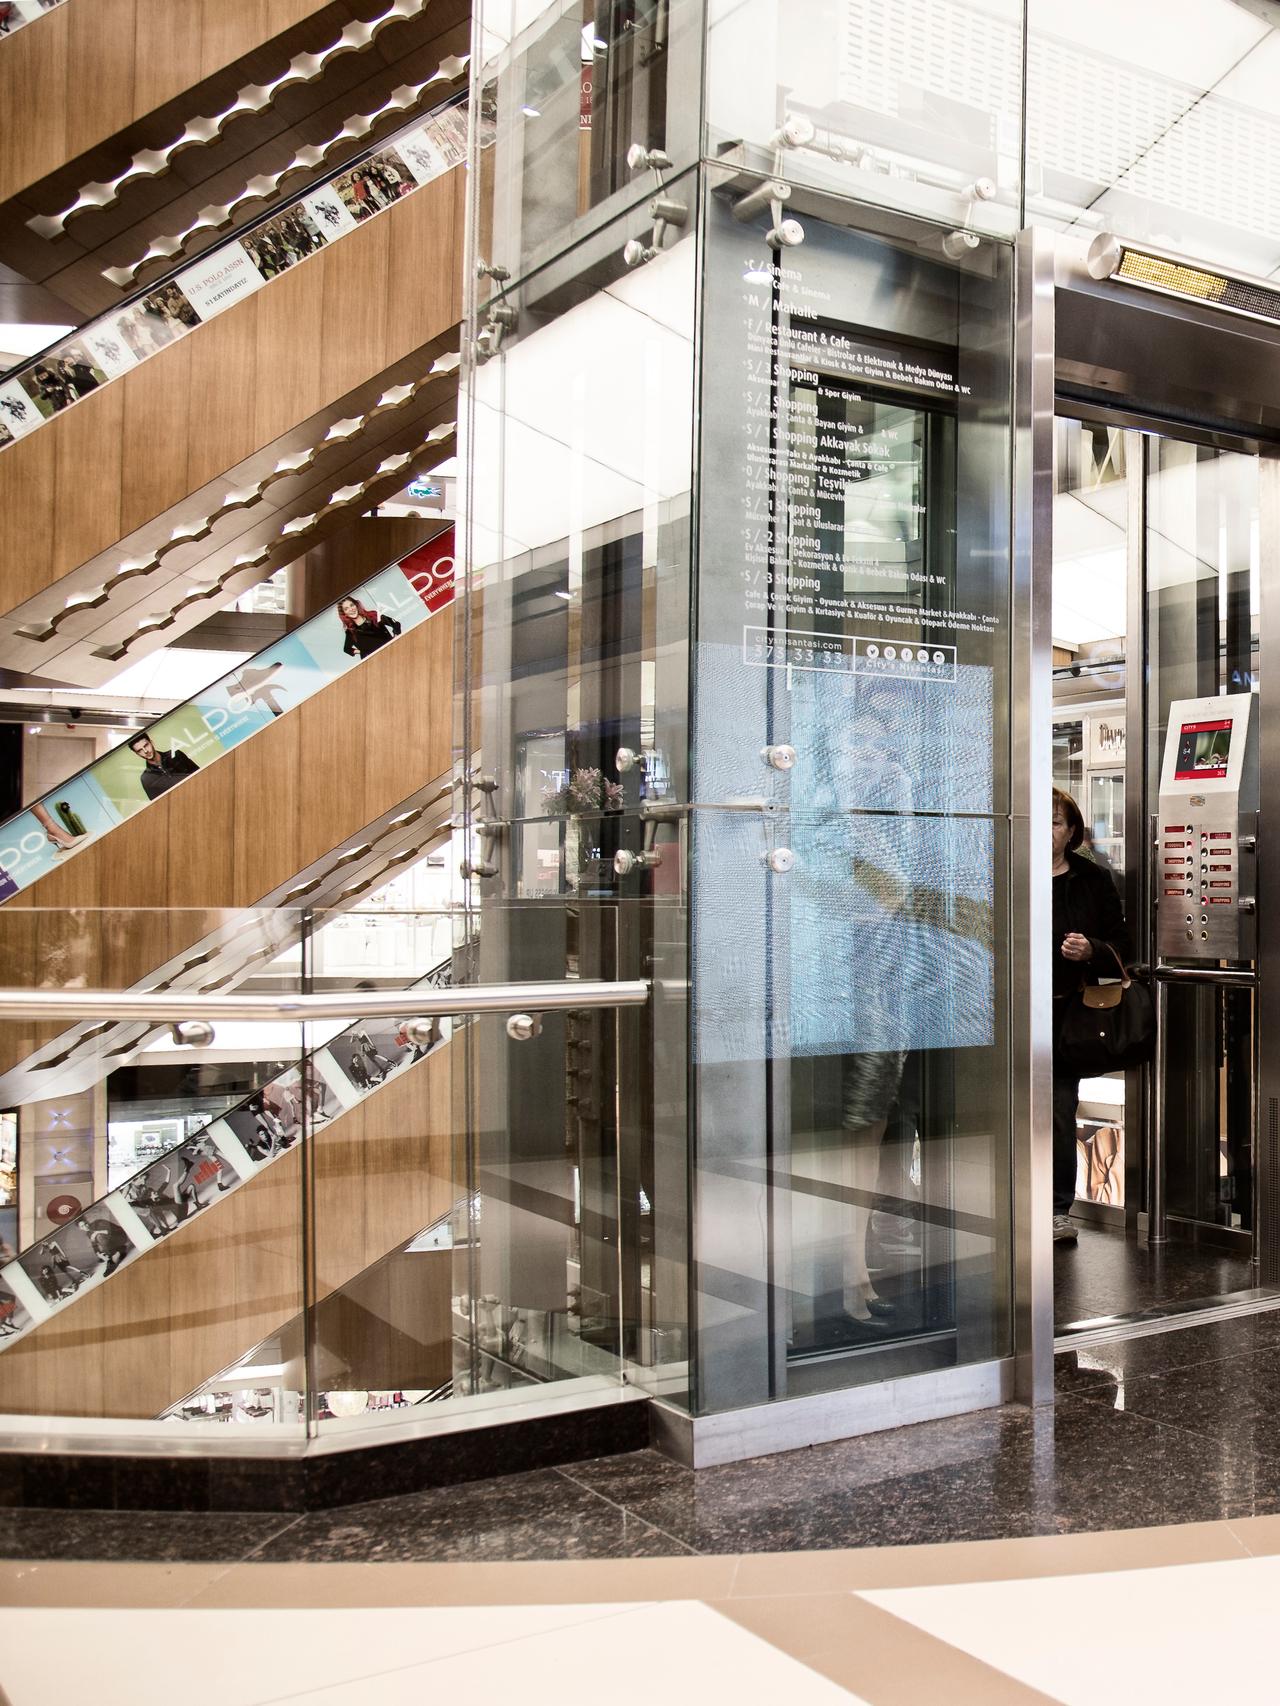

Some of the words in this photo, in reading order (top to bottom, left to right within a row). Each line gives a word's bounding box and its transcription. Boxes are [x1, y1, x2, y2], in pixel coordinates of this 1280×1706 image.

[766, 263, 802, 281] Sinema
[772, 280, 790, 293] Cafe
[748, 294, 760, 307] M
[772, 300, 818, 320] Mahalle
[766, 322, 818, 344] Restaurant
[820, 332, 827, 346] &
[830, 335, 850, 350] Cafe
[797, 342, 821, 355] Cafeler
[827, 346, 856, 362] Bistrolar
[864, 356, 897, 370] Elektronik
[905, 364, 926, 377] Medya
[928, 368, 952, 381] Dünyası
[774, 364, 819, 386] Shopping
[848, 364, 863, 374] Spor
[865, 366, 884, 379] Giyim
[892, 372, 913, 384] Bebek
[914, 376, 934, 388] Bakım
[936, 381, 954, 391] Odası
[962, 386, 971, 395] WC
[824, 388, 840, 400] Spor
[842, 391, 862, 402] Giyim
[774, 396, 818, 417] Shopping
[814, 418, 836, 430] Bayan
[837, 422, 857, 434] Giyim
[773, 428, 818, 449] Shopping
[820, 435, 861, 453] Akkavak
[862, 443, 890, 458] Sokak
[790, 459, 821, 472] Markalar
[829, 466, 861, 479] Kozmetik
[809, 453, 840, 465] Ayakkabı
[765, 467, 810, 488] Shopping
[776, 500, 821, 520] Shopping
[776, 532, 821, 551] Shopping
[755, 544, 784, 556] Aksesua
[793, 547, 834, 562] Dekorasyon
[798, 559, 831, 572] Kozmetik
[910, 572, 928, 582] Odası
[936, 576, 946, 584] WC
[376, 556, 455, 623] ALDO
[776, 573, 820, 592] Shopping
[786, 604, 806, 615] Giyim
[816, 607, 846, 619] Kırtasiye
[854, 611, 876, 621] Kuaför
[885, 614, 913, 626] Oyuncak
[921, 618, 947, 629] Otopark
[948, 620, 970, 630] Ödeme
[971, 624, 994, 633] Noktası
[793, 594, 814, 605] Giyim
[819, 597, 848, 609] Oyuncak
[896, 606, 918, 615] Gurme
[919, 608, 942, 618] Market
[982, 615, 1000, 624] Çanta
[794, 648, 814, 662] 33
[823, 651, 842, 664] 33
[170, 692, 253, 758] ALDO
